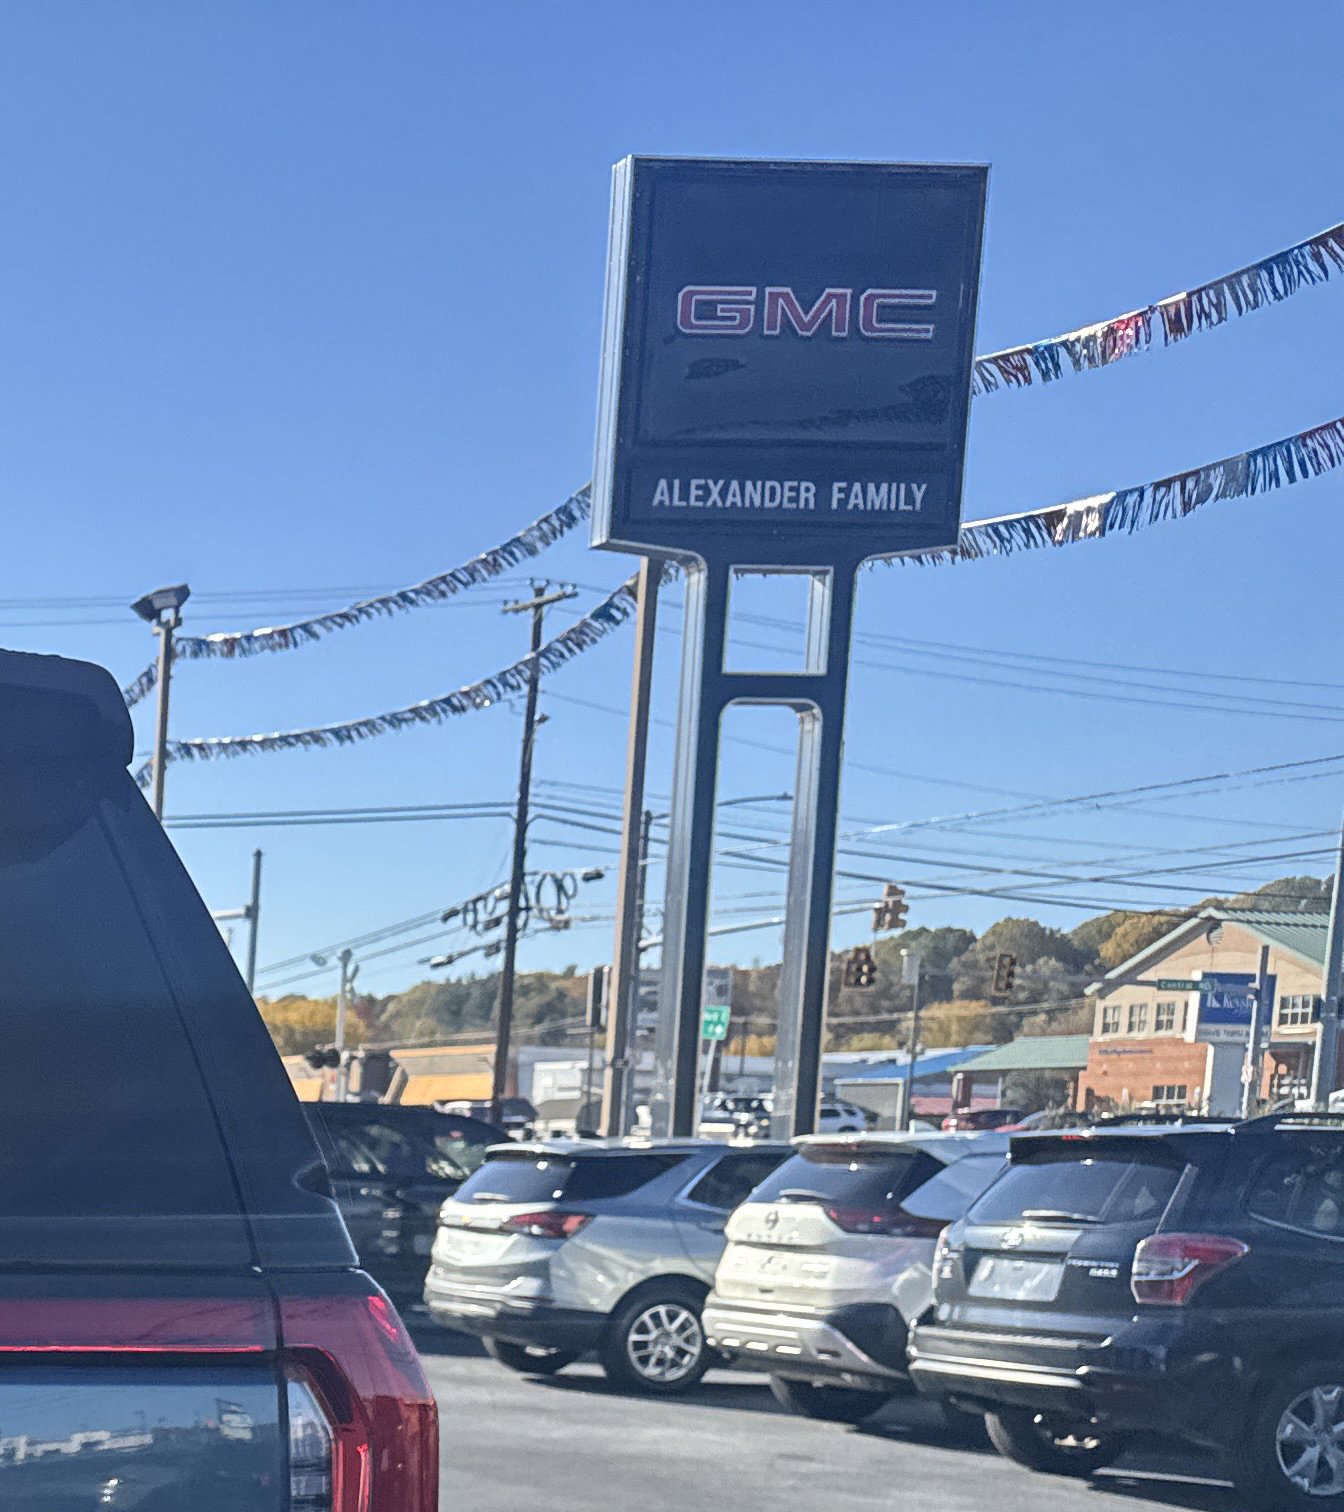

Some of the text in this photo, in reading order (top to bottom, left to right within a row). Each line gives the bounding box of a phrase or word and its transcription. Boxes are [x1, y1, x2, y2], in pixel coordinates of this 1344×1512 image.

[677, 286, 937, 339] GMC
[652, 478, 927, 511] ALEXANDER FAMILY
